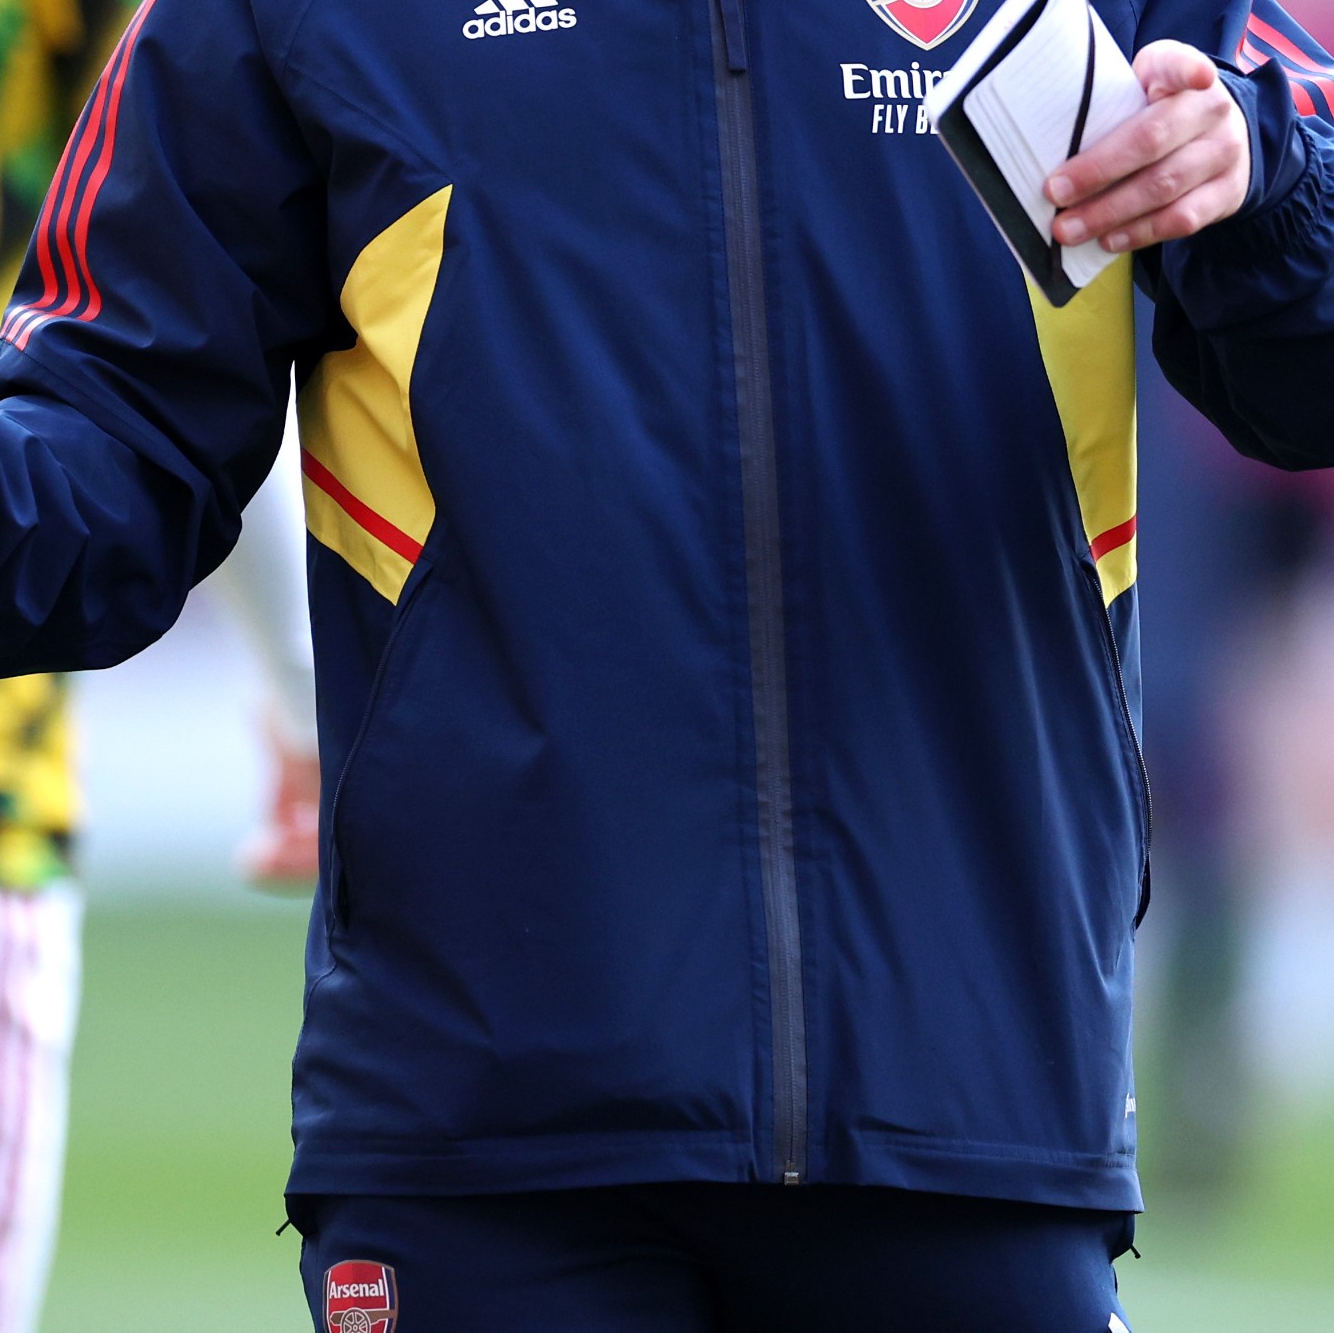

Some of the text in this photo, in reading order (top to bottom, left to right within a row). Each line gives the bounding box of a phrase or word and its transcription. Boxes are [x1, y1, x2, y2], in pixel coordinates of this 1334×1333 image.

[462, 7, 577, 40] adidas
[839, 61, 952, 100] Emir
[872, 104, 909, 134] FLY
[329, 1278, 385, 1299] Arsenal
